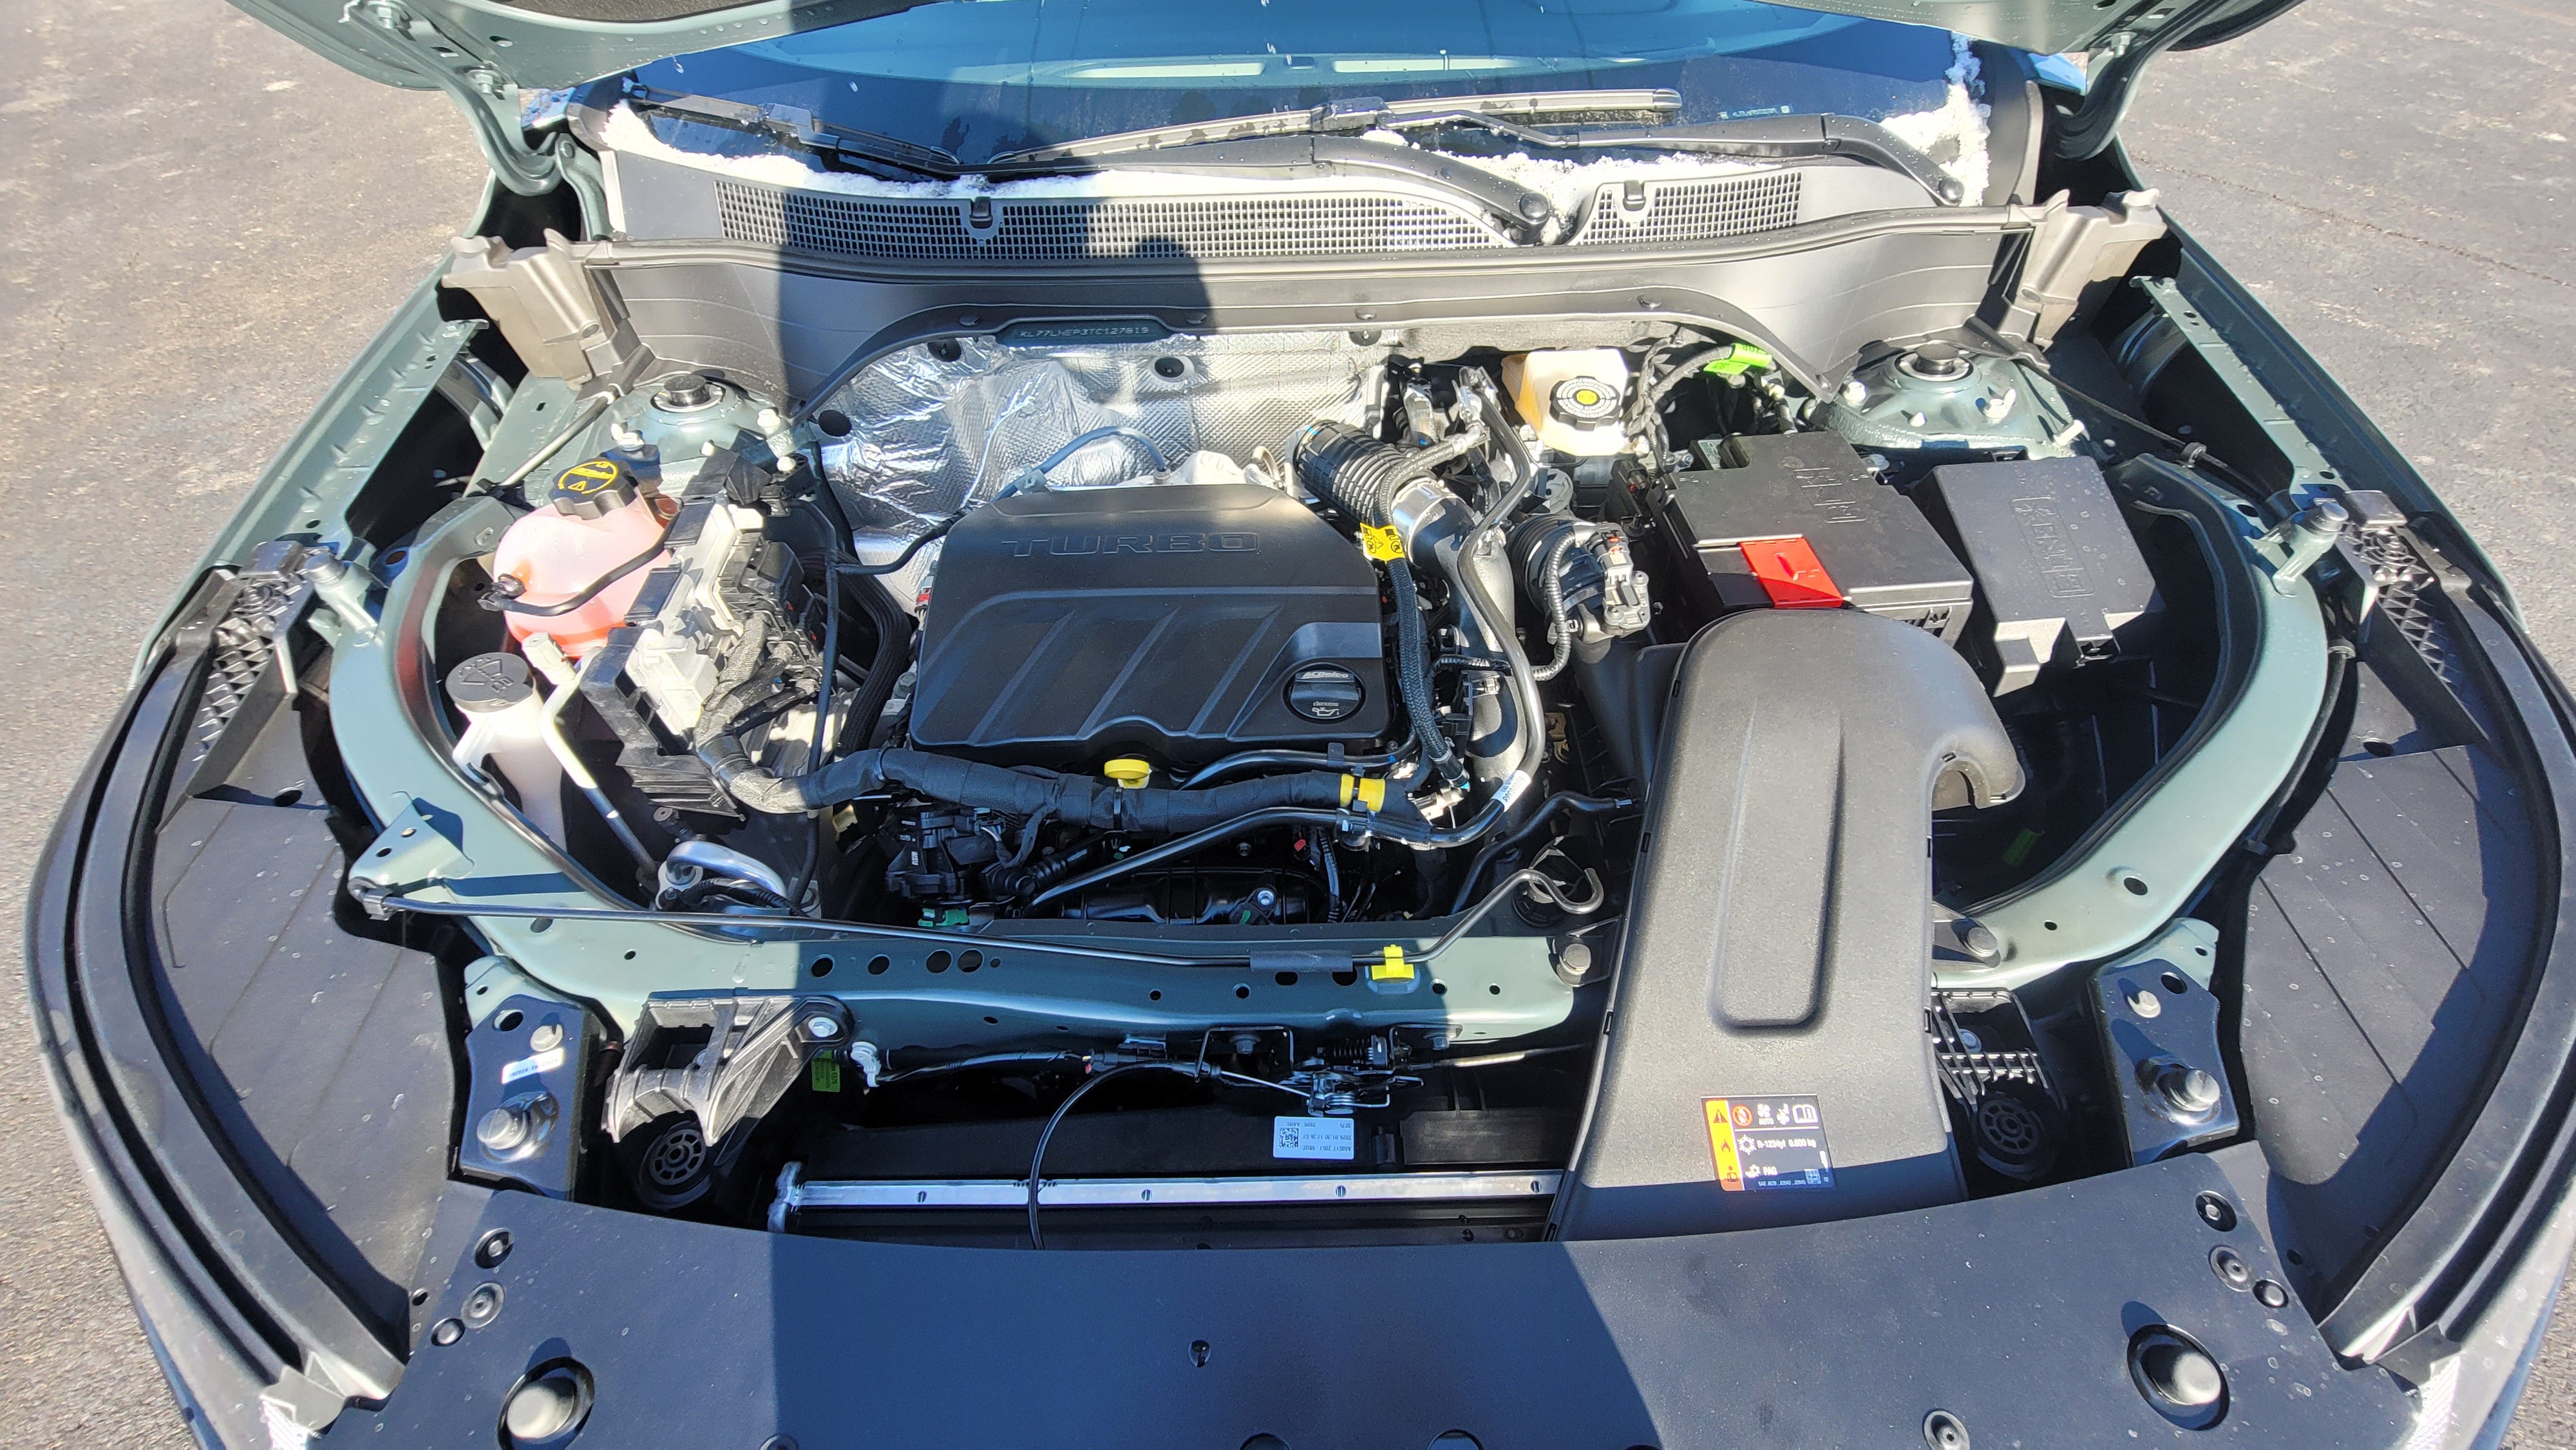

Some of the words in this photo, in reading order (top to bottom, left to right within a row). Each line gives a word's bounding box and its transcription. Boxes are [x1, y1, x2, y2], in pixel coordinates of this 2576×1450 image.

[1001, 532, 1259, 558] TURBO
[1759, 1117, 1775, 1125] AUTO
[1806, 1138, 1817, 1148] kg
[1762, 1166, 1778, 1176] PAG
